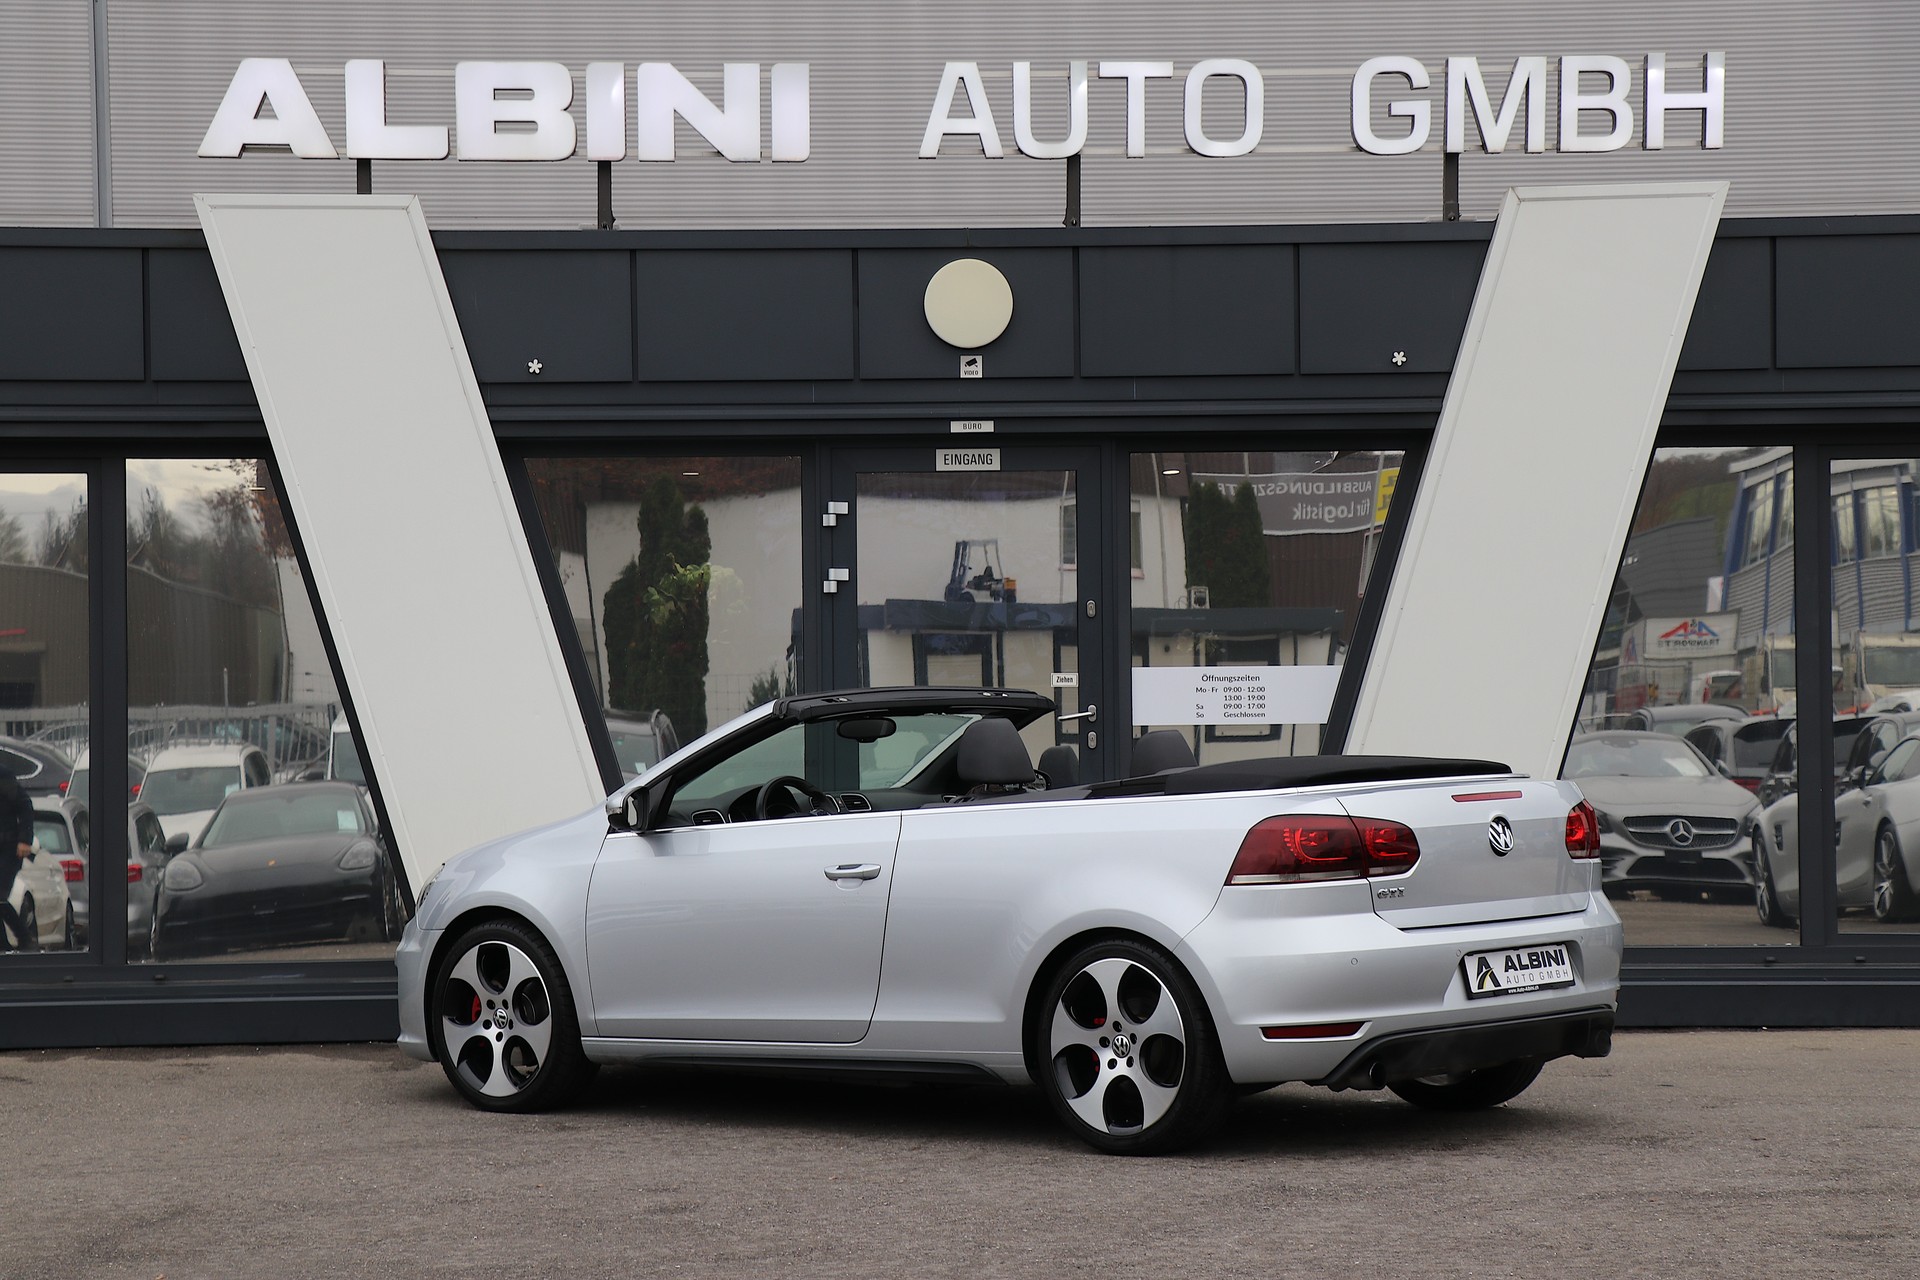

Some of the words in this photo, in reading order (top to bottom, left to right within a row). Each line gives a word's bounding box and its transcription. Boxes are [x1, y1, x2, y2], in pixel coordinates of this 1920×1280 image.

[197, 57, 811, 162] ALBINI
[918, 58, 1265, 159] AUTO
[1351, 51, 1726, 155] GMBH
[962, 422, 982, 430] BÜRO
[943, 453, 993, 466] EINGANG
[1056, 675, 1074, 684] Ziehen
[1201, 674, 1261, 683] Öffnungszeiten
[1504, 949, 1566, 973] ALBINI
[1506, 972, 1535, 985] AUTO
[1538, 969, 1569, 981] GMBH
